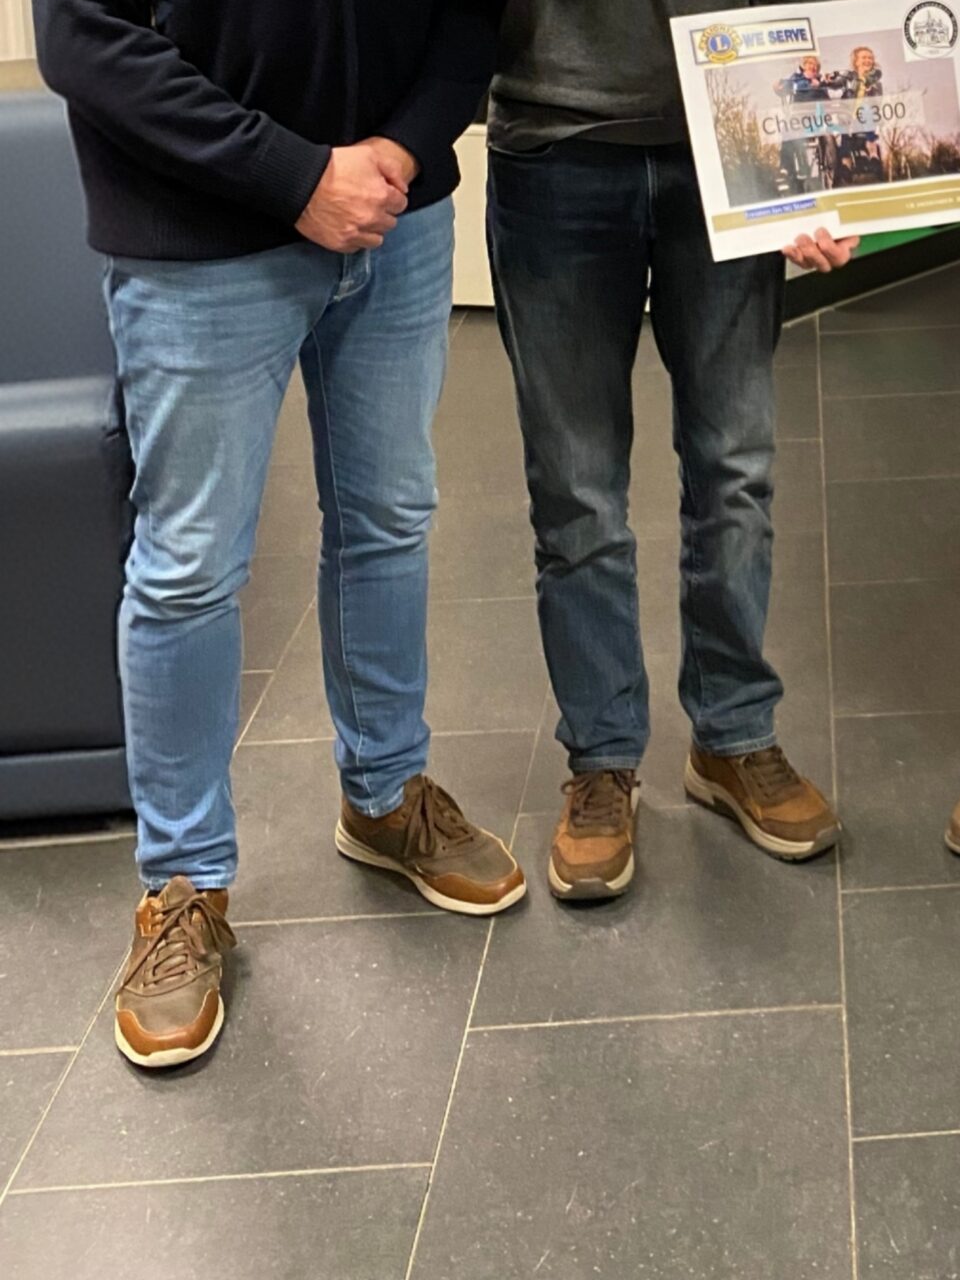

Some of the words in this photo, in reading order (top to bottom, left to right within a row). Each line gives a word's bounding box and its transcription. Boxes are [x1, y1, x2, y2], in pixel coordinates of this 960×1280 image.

[742, 32, 765, 48] WE
[768, 28, 809, 44] SERVE
[762, 113, 833, 135] Cheque
[856, 106, 867, 124] €
[872, 102, 907, 123] 300
